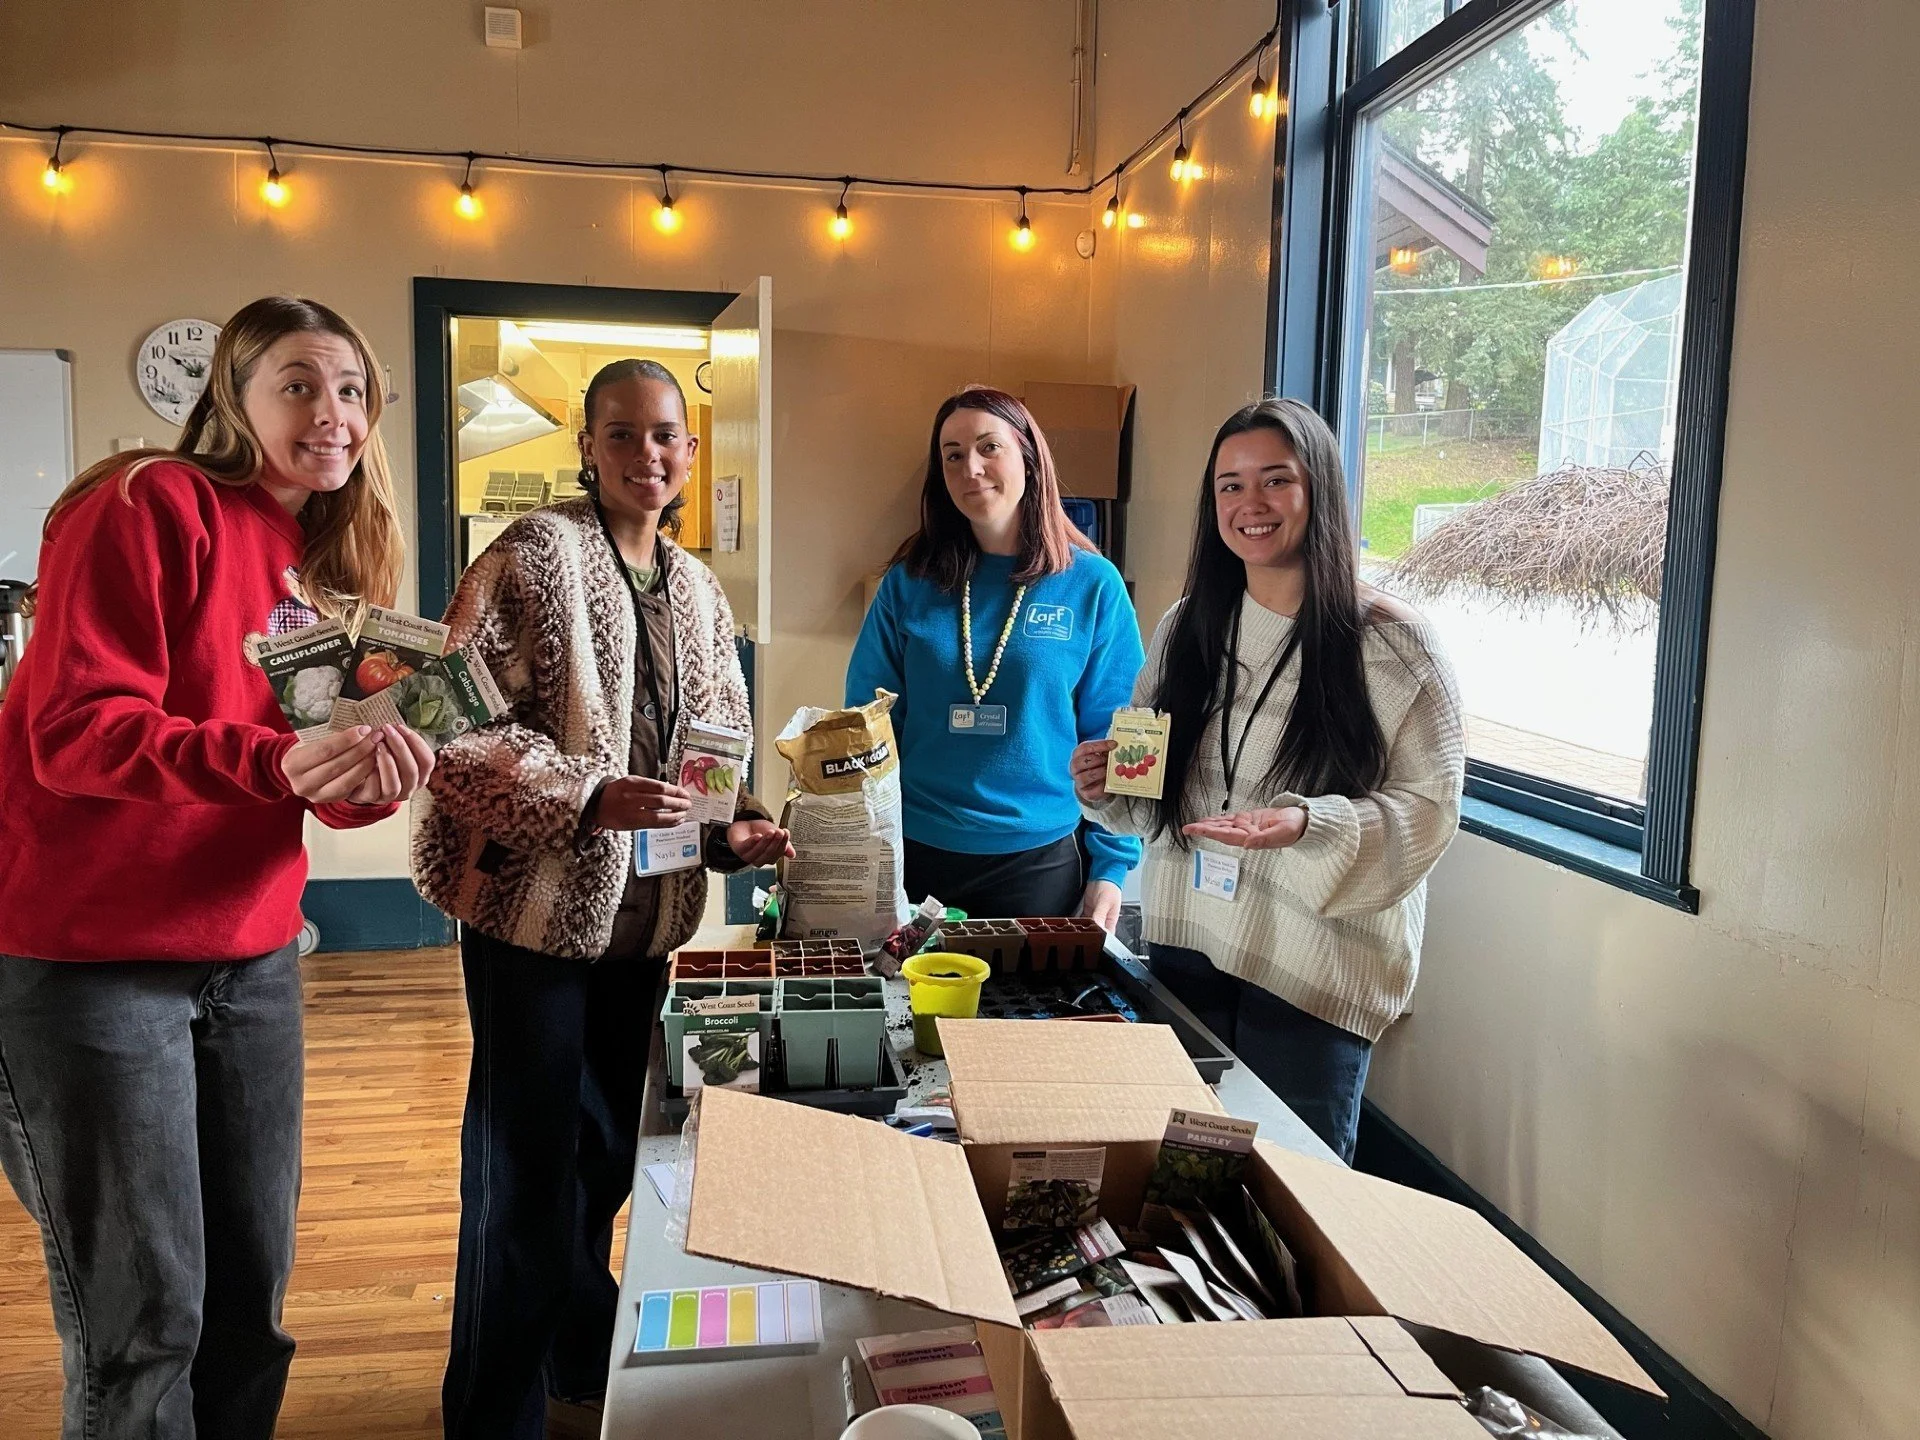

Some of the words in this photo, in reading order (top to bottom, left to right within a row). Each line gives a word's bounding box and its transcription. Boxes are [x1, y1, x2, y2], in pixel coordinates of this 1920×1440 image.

[169, 332, 179, 345] 11
[187, 327, 202, 340] 12
[152, 345, 165, 359] 10
[146, 365, 157, 379] 9
[386, 615, 402, 626] West
[403, 620, 422, 631] Coast
[423, 626, 443, 636] Seeds
[274, 638, 293, 649] West
[294, 632, 316, 644] Coast
[317, 625, 339, 637] Seeds
[378, 627, 429, 645] TOMATOES
[269, 638, 341, 666] CAULIFLOWER
[473, 660, 483, 676] West
[481, 676, 492, 694] Coast
[459, 670, 480, 707] Cabbage
[825, 756, 866, 775] BLACK
[655, 850, 676, 860] Nayla
[737, 1000, 755, 1008] Seeds
[705, 1016, 739, 1026] Broccoli
[1189, 1117, 1207, 1127] West
[1208, 1121, 1229, 1132] Coast
[1230, 1125, 1252, 1135] Seeds
[1187, 1132, 1232, 1147] PARSLEY
